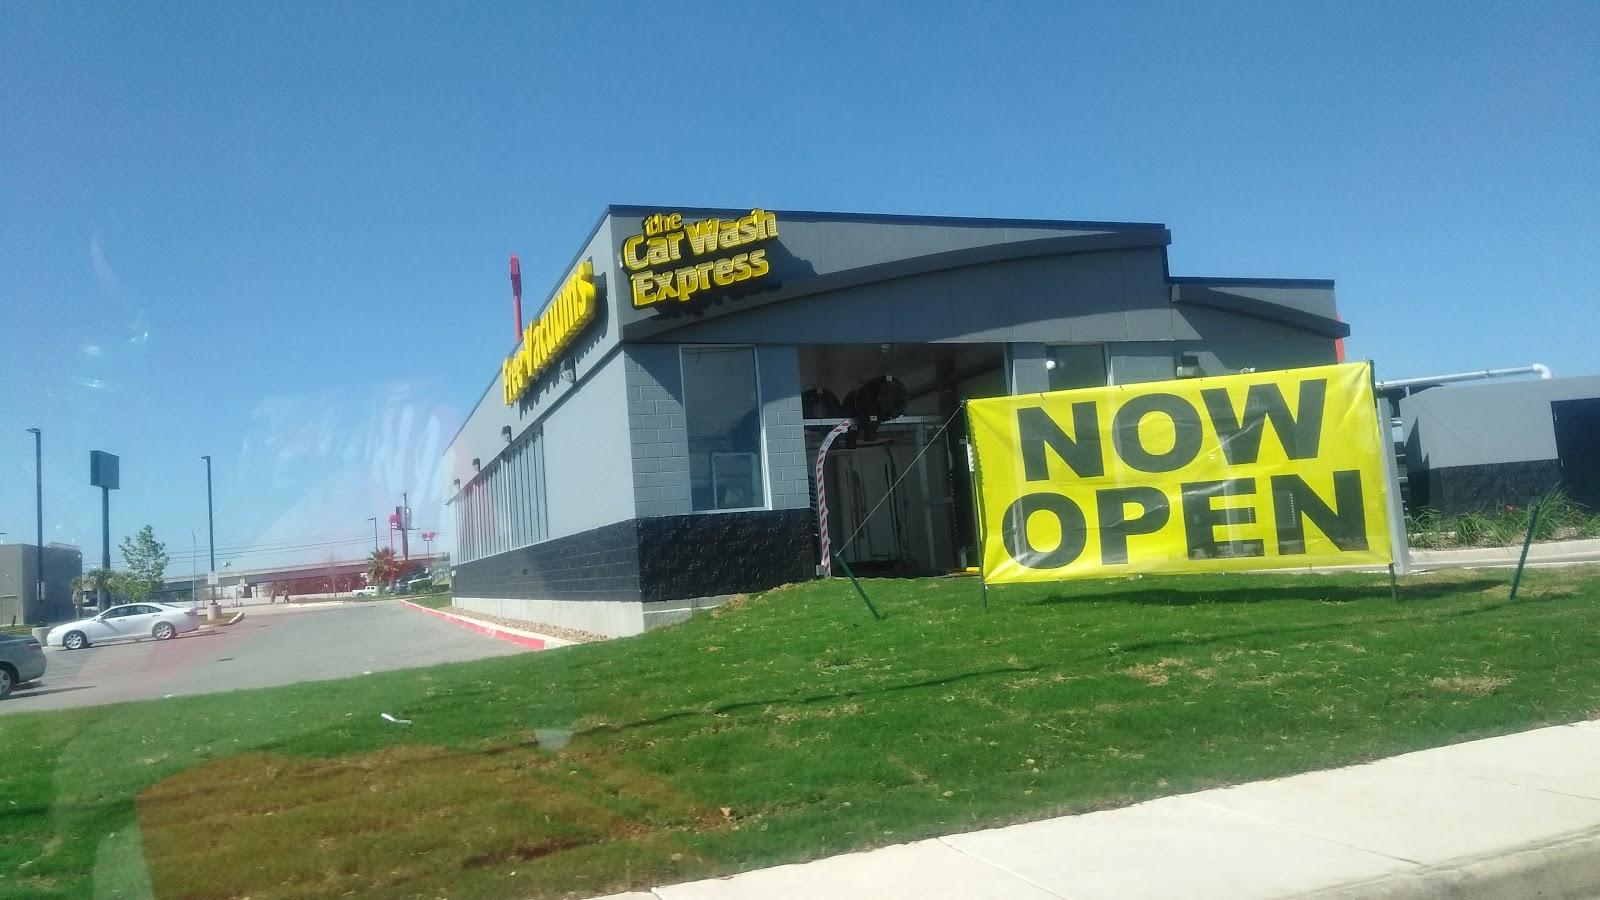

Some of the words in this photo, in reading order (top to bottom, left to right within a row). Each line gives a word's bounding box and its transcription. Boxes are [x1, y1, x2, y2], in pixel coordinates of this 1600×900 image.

[624, 231, 684, 270] Car
[684, 208, 778, 255] Wash
[645, 212, 682, 235] the
[631, 249, 769, 306] Express
[502, 351, 528, 405] Free
[523, 261, 596, 377] Vacuums
[1017, 379, 1327, 481] NOW
[1002, 470, 1369, 569] OPEN
